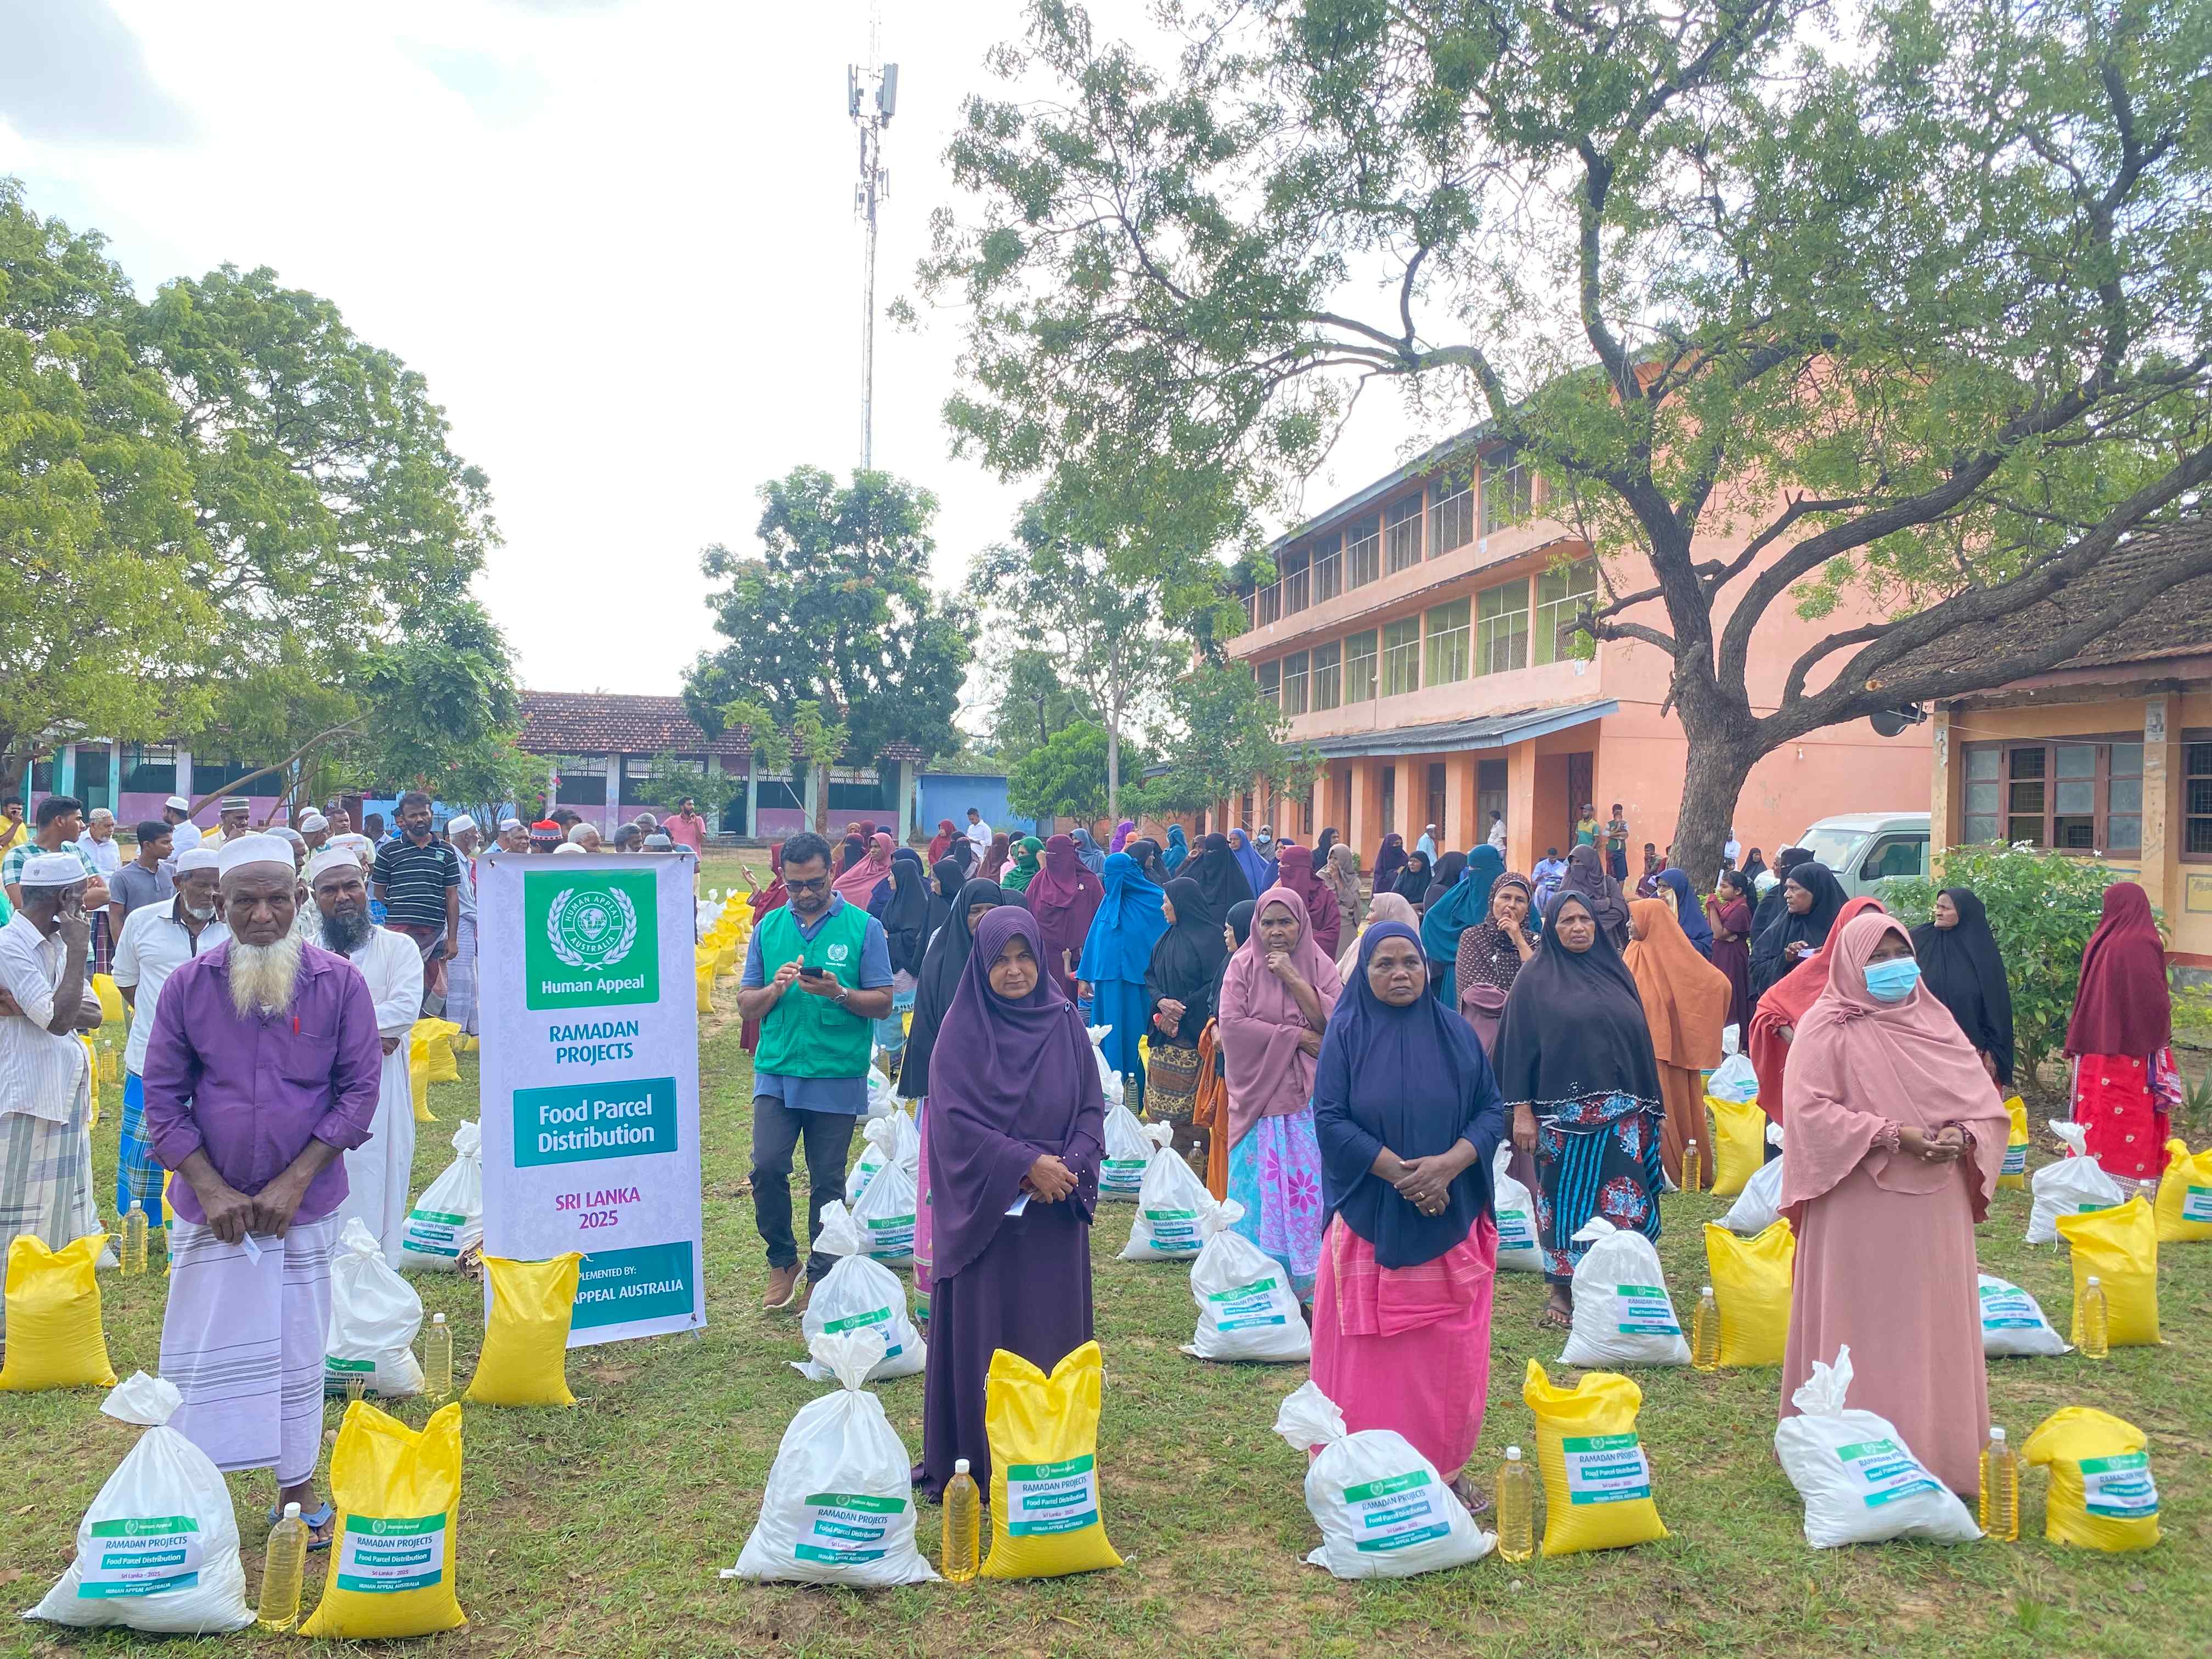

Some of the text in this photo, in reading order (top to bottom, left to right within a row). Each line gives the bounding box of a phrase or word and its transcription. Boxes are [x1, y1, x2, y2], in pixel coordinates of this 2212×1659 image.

[565, 896, 620, 922] HUMAN APPEAL
[570, 936, 615, 952] AUSTRALIA
[542, 974, 644, 994] Human Appeal
[550, 1020, 639, 1042] RAMADAN
[557, 1043, 633, 1066] PROJECTS
[540, 1094, 653, 1125] Food Parcel
[539, 1124, 654, 1153] Distribution
[556, 1187, 641, 1211] SRI LANKA
[579, 1210, 618, 1229] 2025
[579, 1266, 636, 1280] PLEMENTED BY:
[574, 1279, 684, 1304] APPEAL AUSTRALIA
[1580, 1454, 1615, 1463] RAMADAN
[1858, 1457, 1892, 1466] RAMADAN
[1023, 1476, 1086, 1492] RAMADAN PROJECTS
[1059, 1493, 1085, 1504] Distribution
[1362, 1489, 1425, 1510] RAMADAN PROJECTS
[818, 1509, 888, 1526] RAMADAN PROJECTS
[1383, 1513, 1398, 1521] Parcel
[1399, 1505, 1427, 1518] Distribution
[357, 1536, 432, 1548] RAMADAN PROJECTS
[851, 1530, 881, 1538] Distribution
[106, 1536, 187, 1549] RAMADAN PROJECTS
[106, 1557, 122, 1565] Food
[143, 1554, 181, 1564] Distribution
[392, 1554, 427, 1562] Distribution
